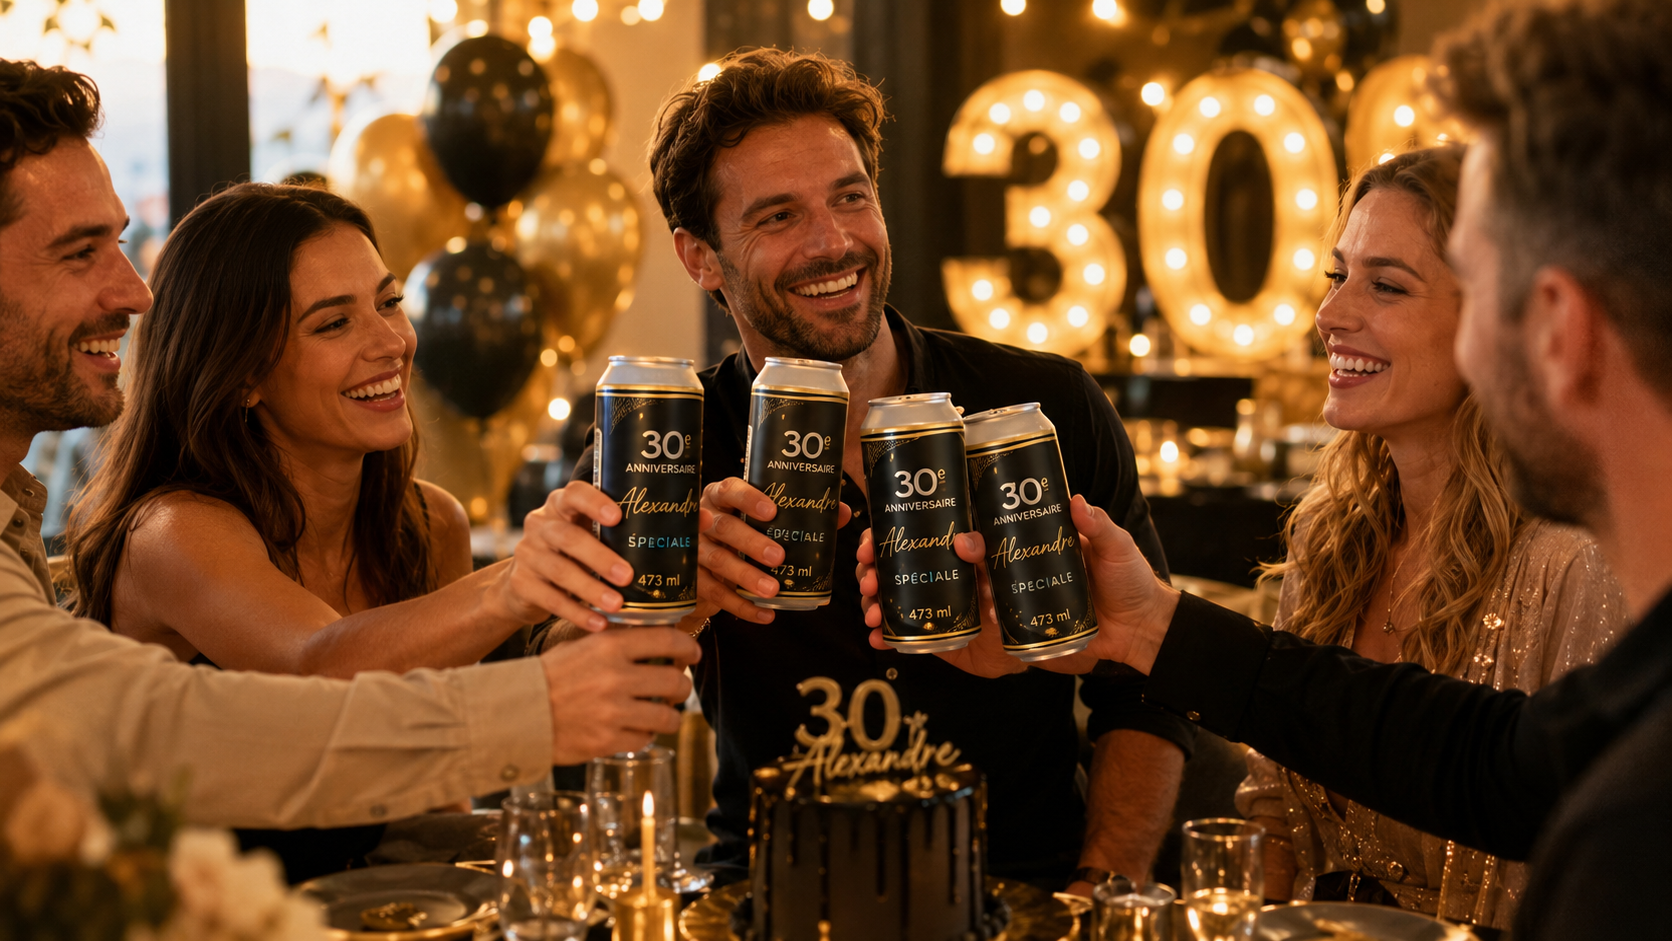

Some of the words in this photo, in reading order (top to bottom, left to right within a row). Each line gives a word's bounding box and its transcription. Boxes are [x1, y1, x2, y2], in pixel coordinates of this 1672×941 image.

[942, 56, 1472, 360] 30
[640, 430, 692, 460] 30e
[781, 430, 831, 459] 30e
[625, 462, 696, 474] ANNIVERSAIRE
[767, 460, 835, 474] ANNIVERSAIRE
[894, 467, 946, 498] 30e
[1000, 477, 1049, 510] 30e
[884, 497, 957, 513] ANNIVERSAIRE
[993, 503, 1062, 526] ANNIVERSAIRE
[879, 520, 956, 558] Alexandr
[991, 525, 1075, 570] Alexandre
[637, 574, 663, 587] 473
[666, 574, 680, 586] ml
[770, 564, 795, 576] 473
[797, 565, 813, 577] ml
[908, 607, 934, 620] 473
[936, 605, 952, 618] ml
[1029, 613, 1054, 627] 473
[1056, 608, 1071, 622] ml
